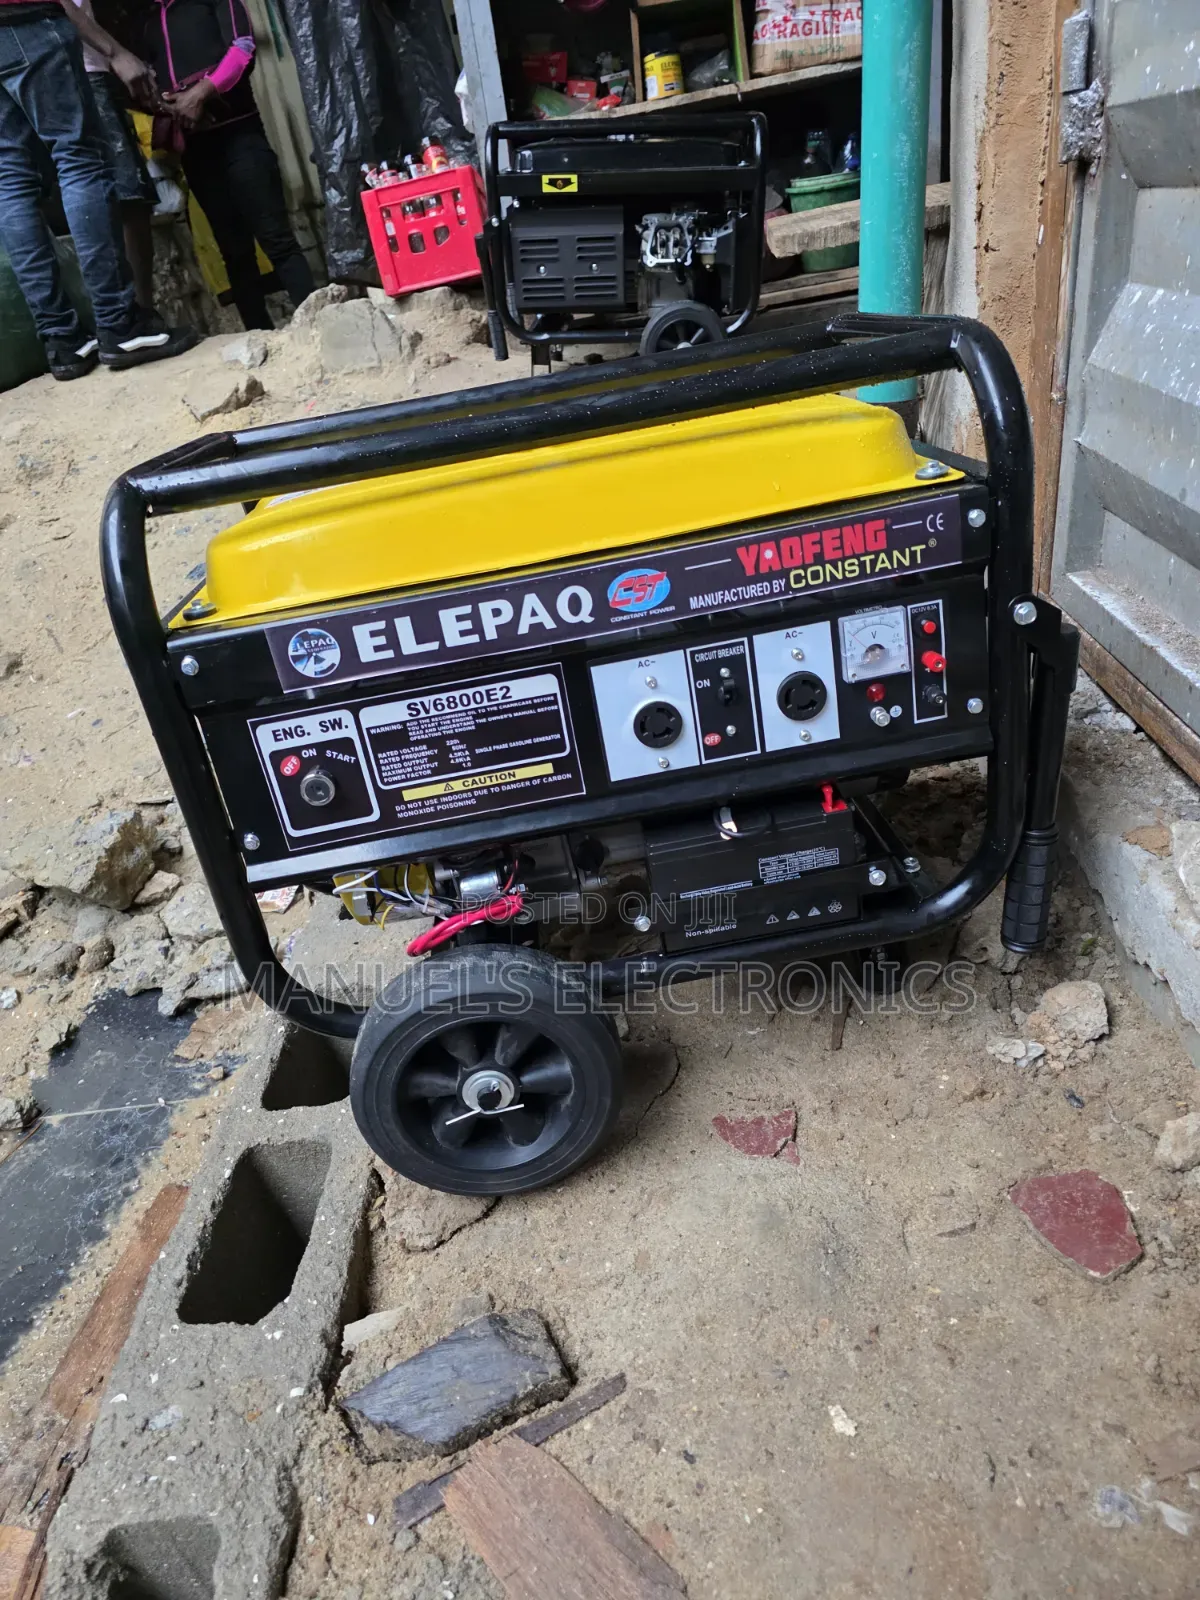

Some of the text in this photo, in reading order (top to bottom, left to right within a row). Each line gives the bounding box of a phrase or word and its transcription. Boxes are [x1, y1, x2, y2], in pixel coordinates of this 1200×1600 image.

[736, 519, 888, 577] YAOFENG
[689, 544, 927, 610] MANUFACTURED BY CONSTANT
[609, 571, 667, 608] CST
[610, 605, 676, 623] CONSTANT POWER
[351, 585, 595, 663] ELEPAQ
[694, 645, 745, 663] CIRCUIT BREAKER
[696, 678, 711, 689] ON
[406, 685, 512, 718] SV6800E2
[369, 723, 404, 735] WARNING:
[431, 712, 467, 722] RECOMMEND
[533, 696, 555, 704] BEFORE
[437, 720, 475, 731] UNDERSTAND
[487, 713, 513, 722] OWNER'S
[513, 709, 536, 718] MANUAL
[537, 705, 558, 713] BEFORE
[271, 717, 349, 743] ENG. SW.
[409, 732, 442, 742] OPERATING
[454, 725, 476, 733] ENGINE
[704, 735, 720, 745] OFF
[301, 748, 357, 764] ON START
[378, 750, 399, 759] RATED
[400, 744, 428, 755] VOLTAGE
[379, 755, 400, 765] RATED
[401, 748, 438, 761] FREQUENCY
[381, 762, 402, 771] RATED
[403, 757, 428, 767] OUTPUT
[475, 745, 493, 754] SINGLE
[493, 742, 509, 751] PHASE
[509, 738, 533, 748] GASOLINE
[533, 733, 561, 744] GENERATOR
[283, 756, 299, 775] OFF
[382, 767, 413, 777] MAXIMUM
[413, 761, 439, 771] OUTPUT
[383, 774, 406, 783] POWER
[407, 769, 432, 779] FACTOR
[462, 771, 517, 788] CAUTION
[407, 801, 422, 809] NOT
[424, 798, 440, 806] USE
[440, 792, 473, 803] INDOORS
[473, 788, 489, 796] DUE
[490, 786, 500, 794] TO
[501, 780, 531, 791] DANGER
[532, 778, 541, 786] OF
[542, 772, 572, 784] CARBON
[397, 798, 477, 819] MONOXIDE POISONING
